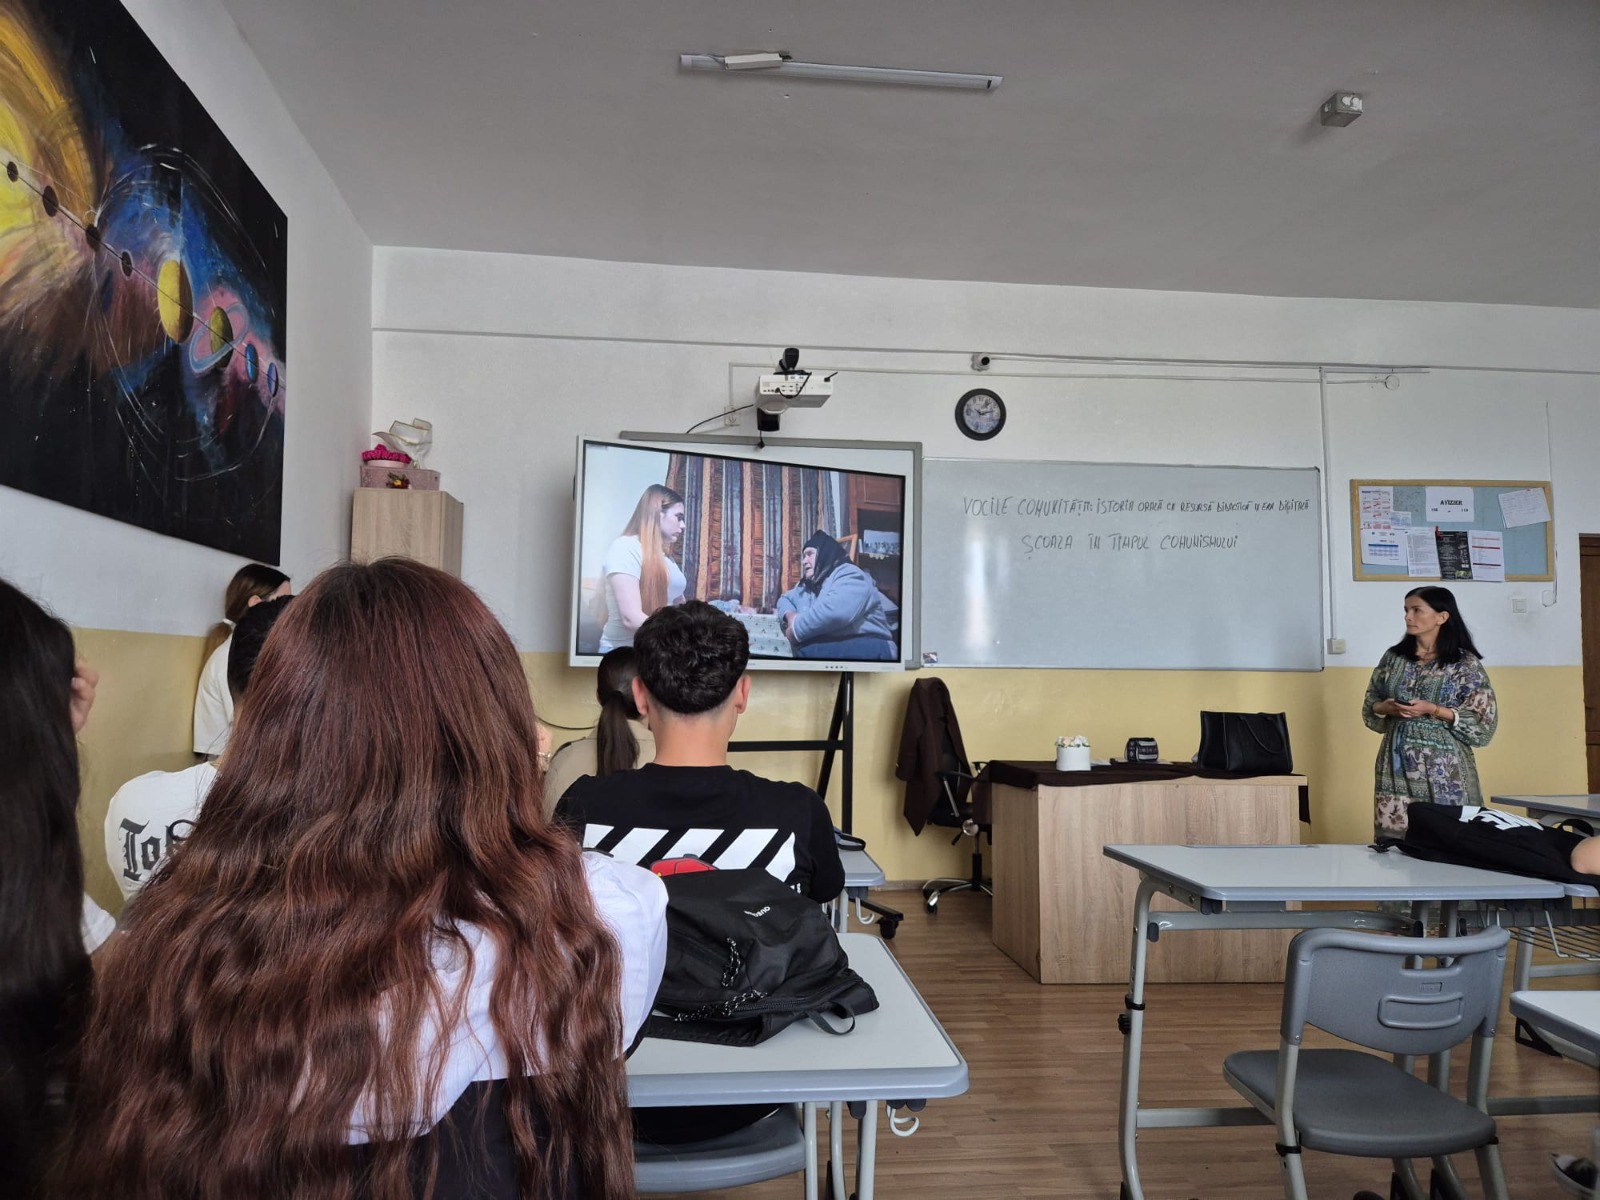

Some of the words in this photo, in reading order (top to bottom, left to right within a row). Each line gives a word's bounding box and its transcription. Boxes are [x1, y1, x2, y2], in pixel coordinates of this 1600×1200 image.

[963, 496, 1013, 516] VOCILE
[1096, 498, 1135, 514] ISTORIA
[1087, 533, 1101, 550] ÎN
[1107, 532, 1150, 551] TIMPUL
[1160, 533, 1238, 550] COMUNISMULUI
